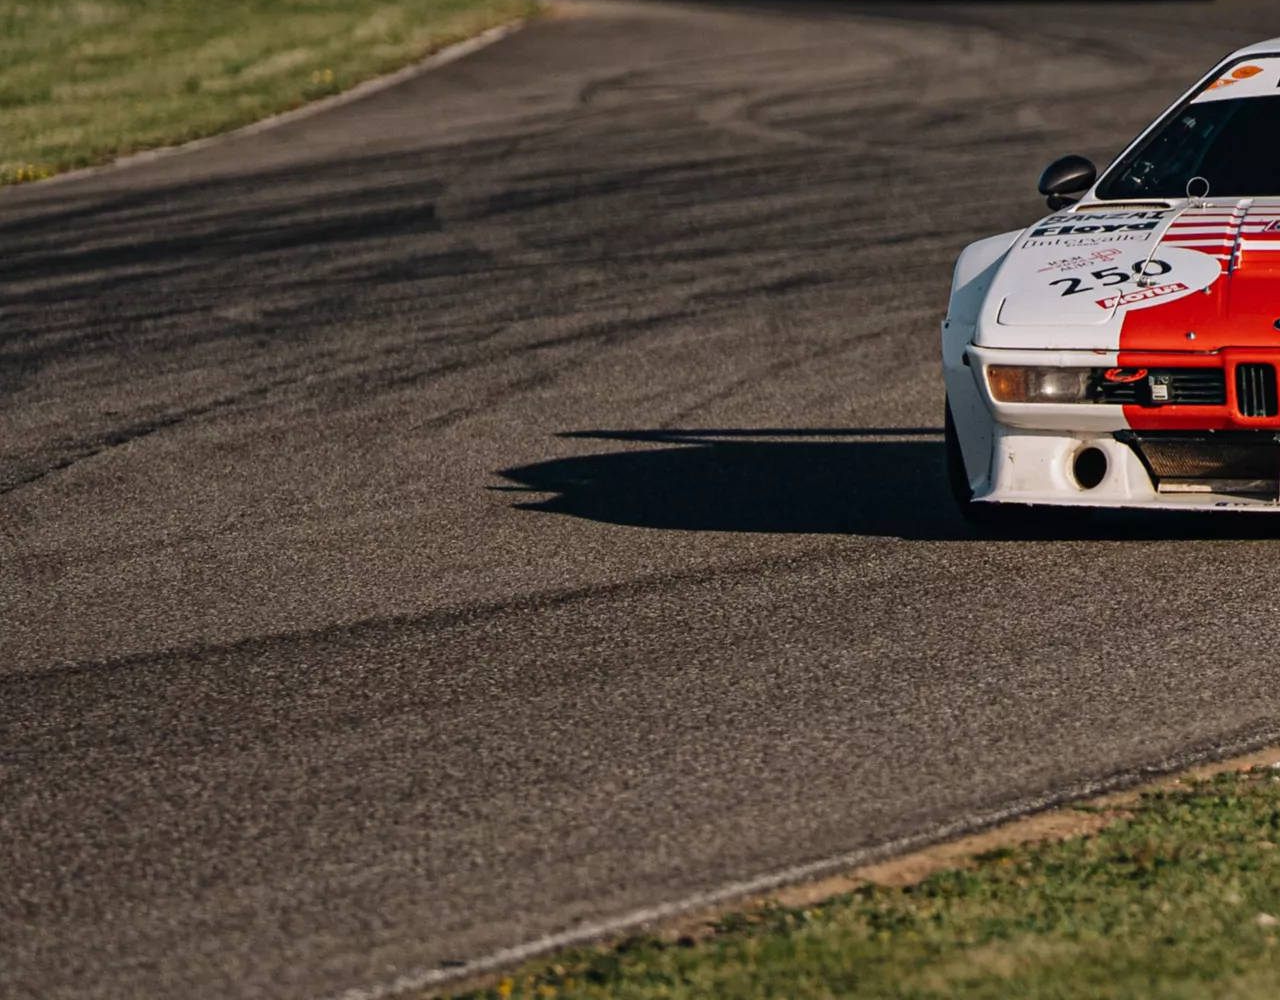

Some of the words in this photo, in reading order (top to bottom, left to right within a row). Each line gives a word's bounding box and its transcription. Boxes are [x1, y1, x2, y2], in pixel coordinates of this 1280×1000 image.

[1040, 211, 1164, 226] BANZAI
[1030, 221, 1159, 238] Floyd
[1049, 259, 1172, 297] 250
[1103, 284, 1186, 307] MOTUL
